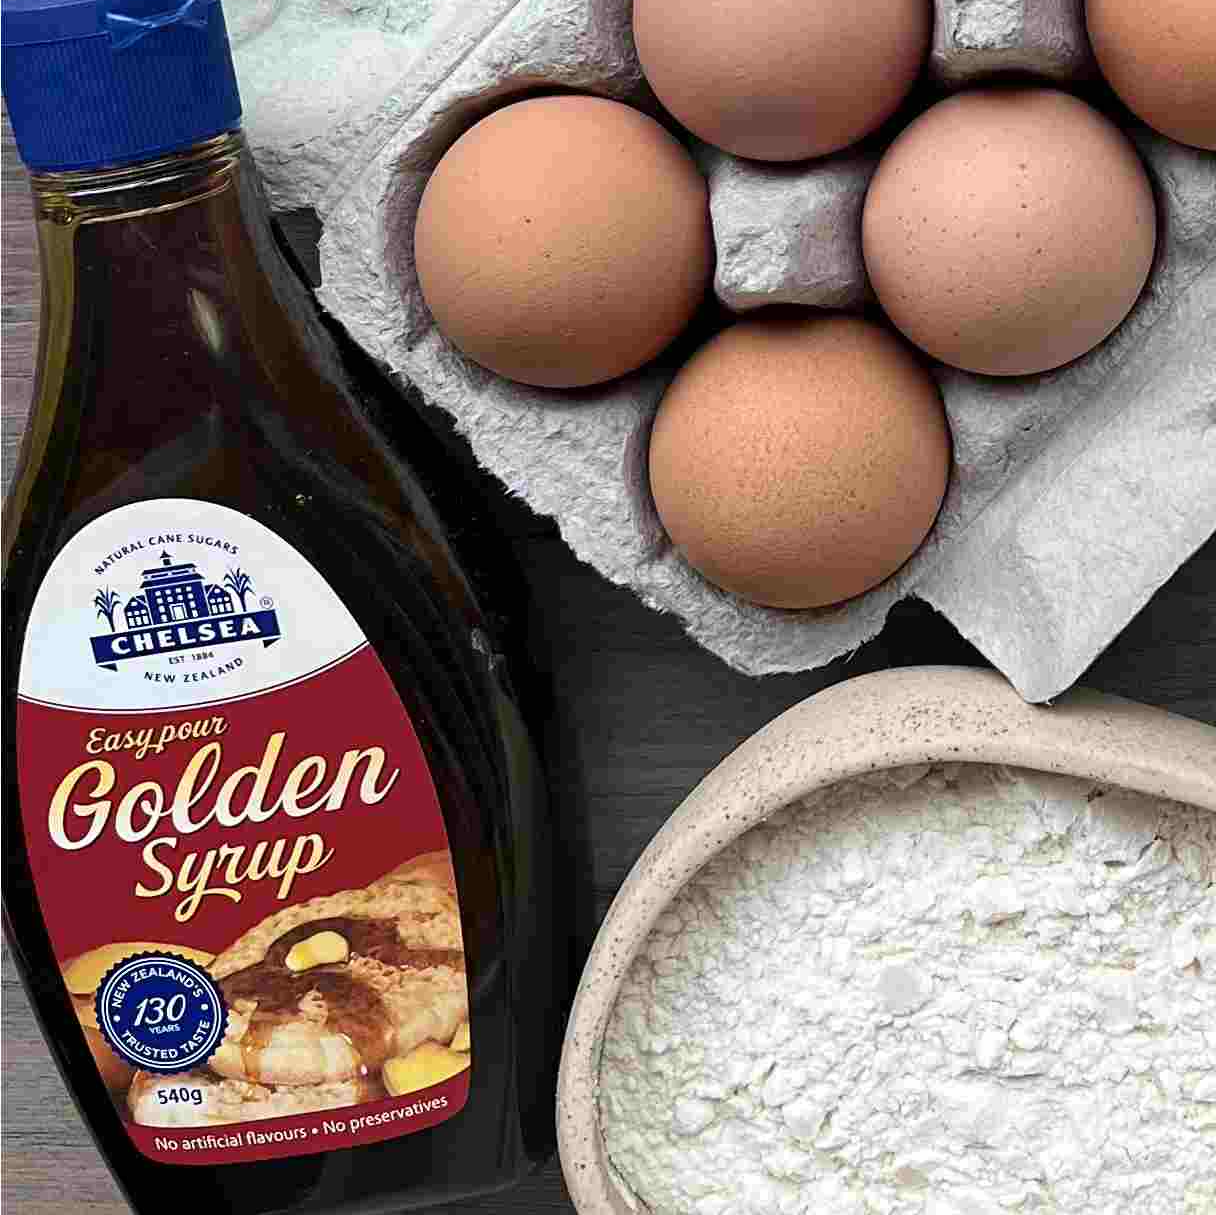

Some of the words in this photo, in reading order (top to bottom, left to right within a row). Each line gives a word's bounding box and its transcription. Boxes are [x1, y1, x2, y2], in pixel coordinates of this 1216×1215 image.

[94, 540, 145, 575] NATURAL
[148, 534, 183, 546] CANE
[187, 534, 240, 556] SUGARS
[110, 617, 262, 655] CHELSEA
[143, 671, 176, 683] NEW
[183, 657, 243, 683] ZEALAND
[168, 656, 185, 665] EST
[86, 727, 158, 759] Easy
[157, 714, 228, 754] pour
[47, 731, 401, 851] Golden
[134, 831, 335, 923] Syrup
[112, 978, 132, 1009] NEW
[130, 967, 205, 998] ZEALAND'S
[134, 993, 187, 1027] 130
[148, 1023, 181, 1035] YEARS
[120, 1029, 179, 1059] TRUSTED
[180, 1019, 211, 1053] TASTE
[157, 1087, 203, 1106] 540g
[154, 1136, 179, 1152] No
[181, 1132, 244, 1152] artificial
[246, 1125, 308, 1146] flavours
[322, 1119, 347, 1135] No
[349, 1094, 449, 1134] preservatives
